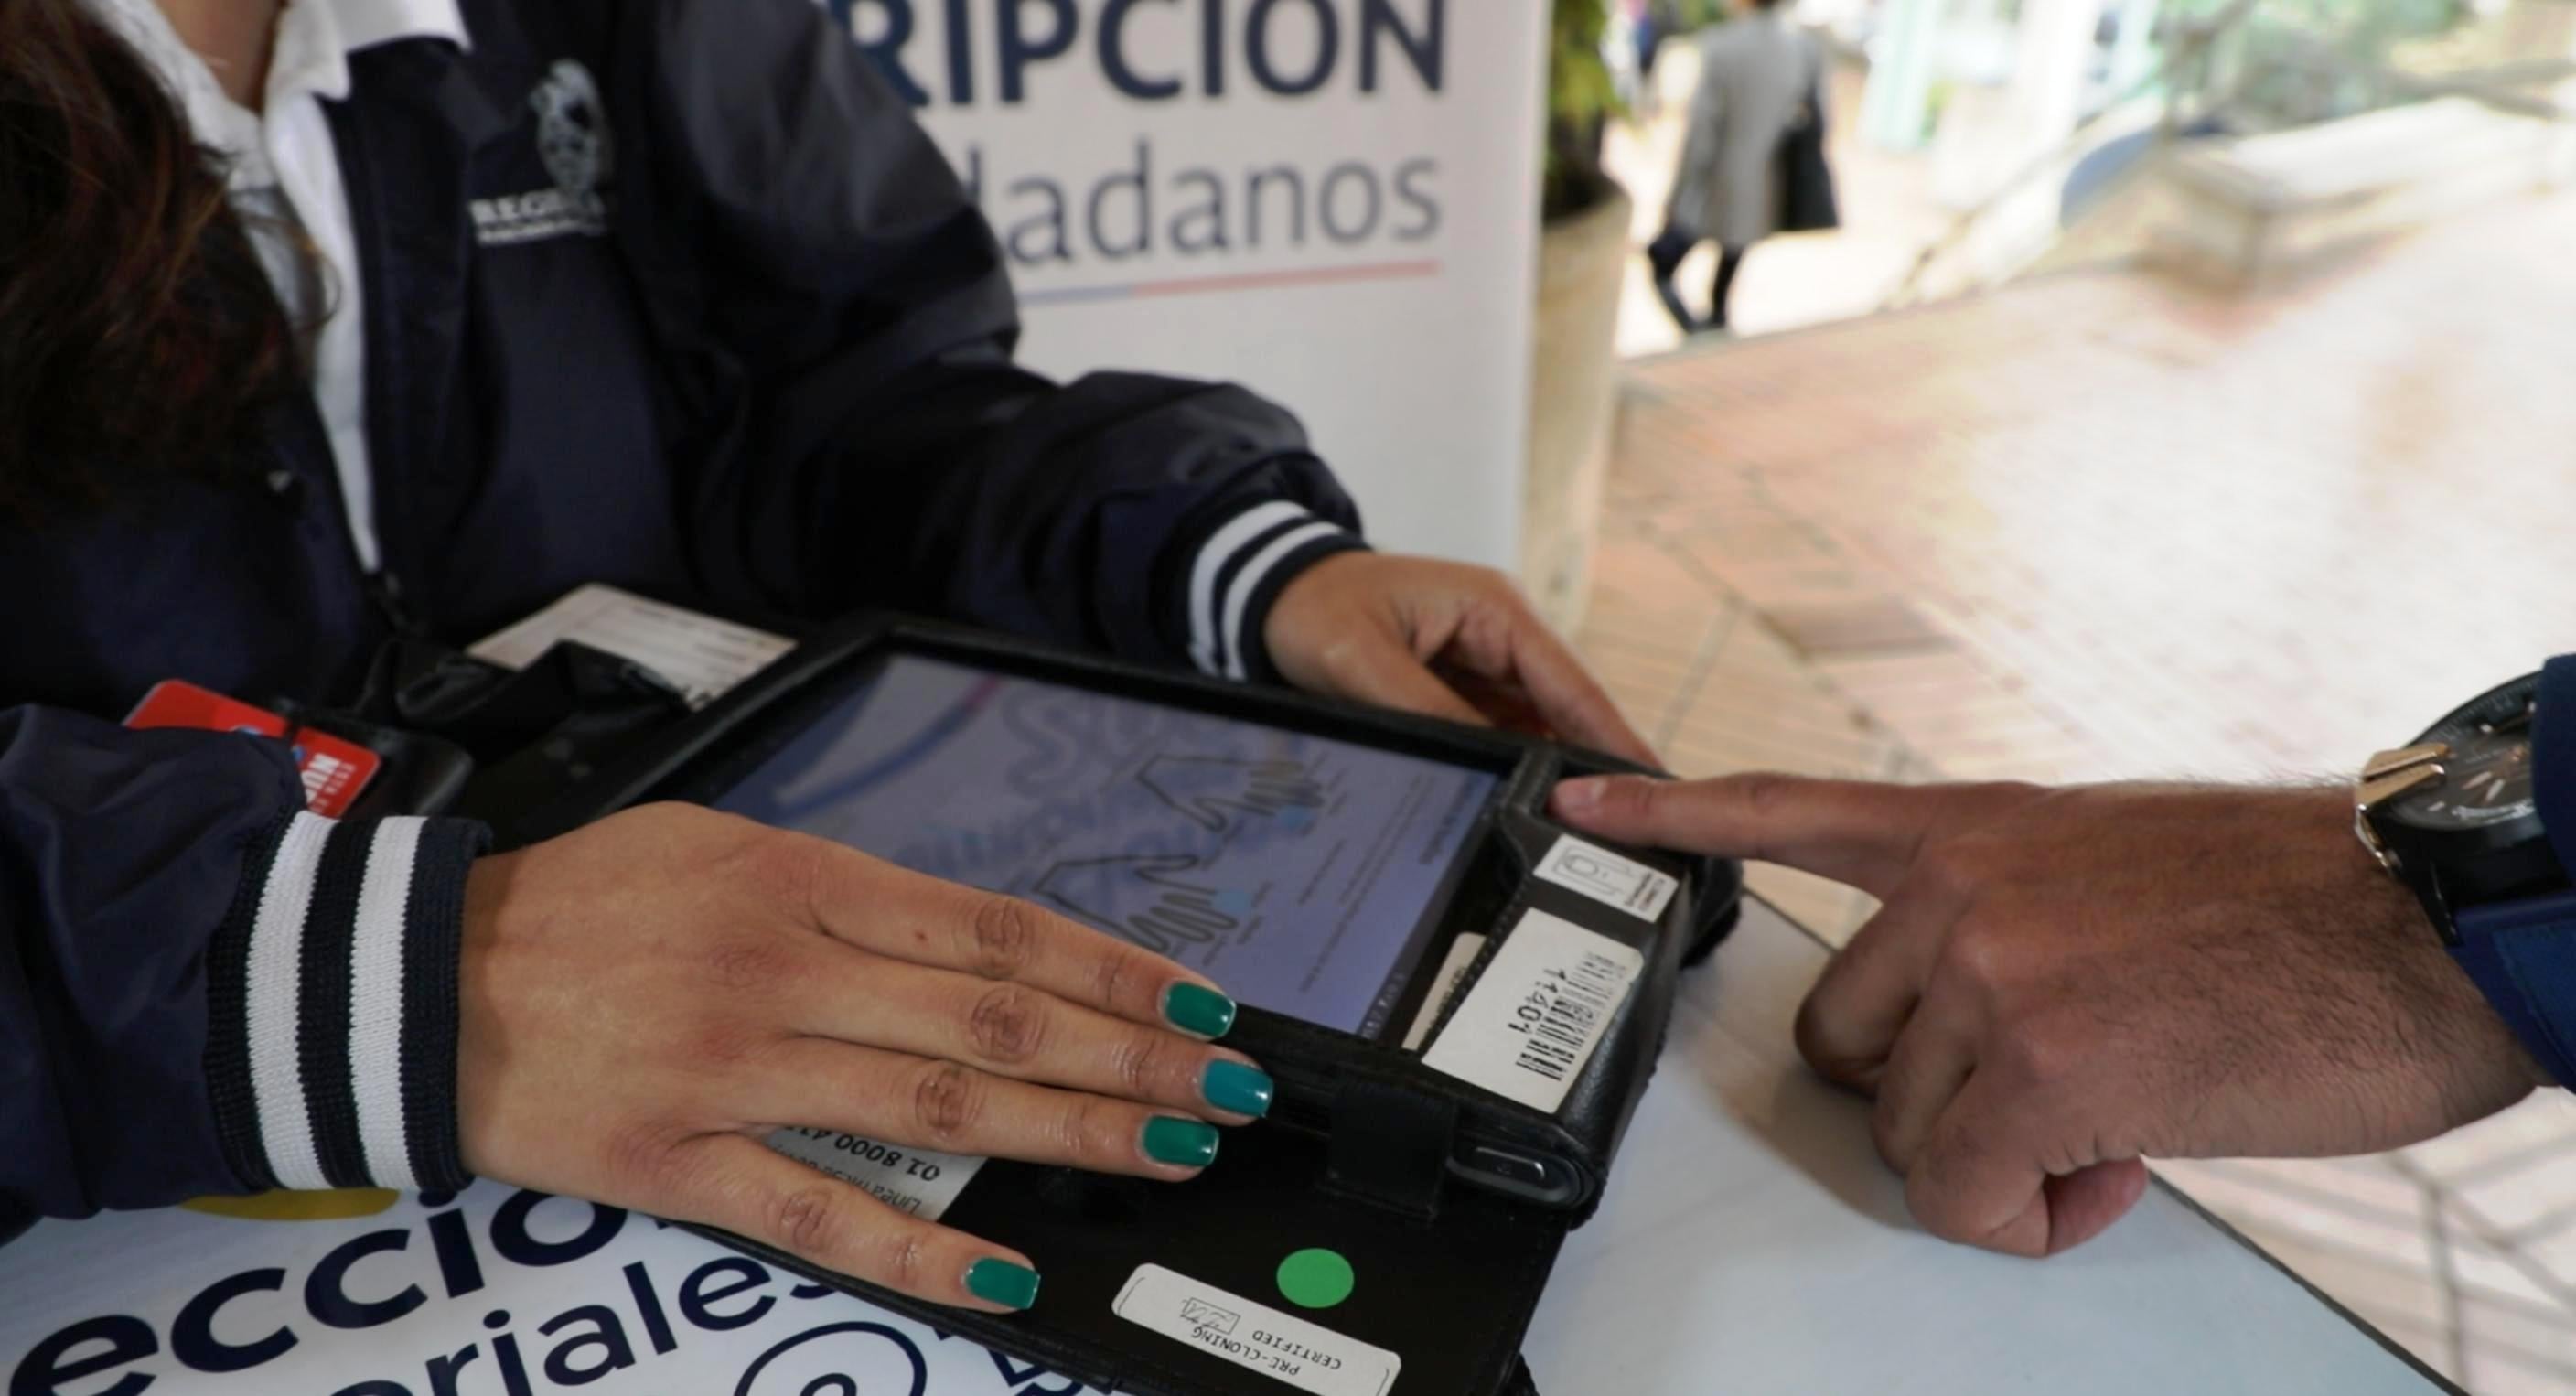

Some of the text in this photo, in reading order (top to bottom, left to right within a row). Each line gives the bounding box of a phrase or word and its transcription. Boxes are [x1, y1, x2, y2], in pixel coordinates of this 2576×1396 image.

[834, 1133, 903, 1168] 8000
[906, 1157, 941, 1182] 01
[7, 1187, 675, 1396] eccio
[1252, 1328, 1342, 1370] CERTIFIED
